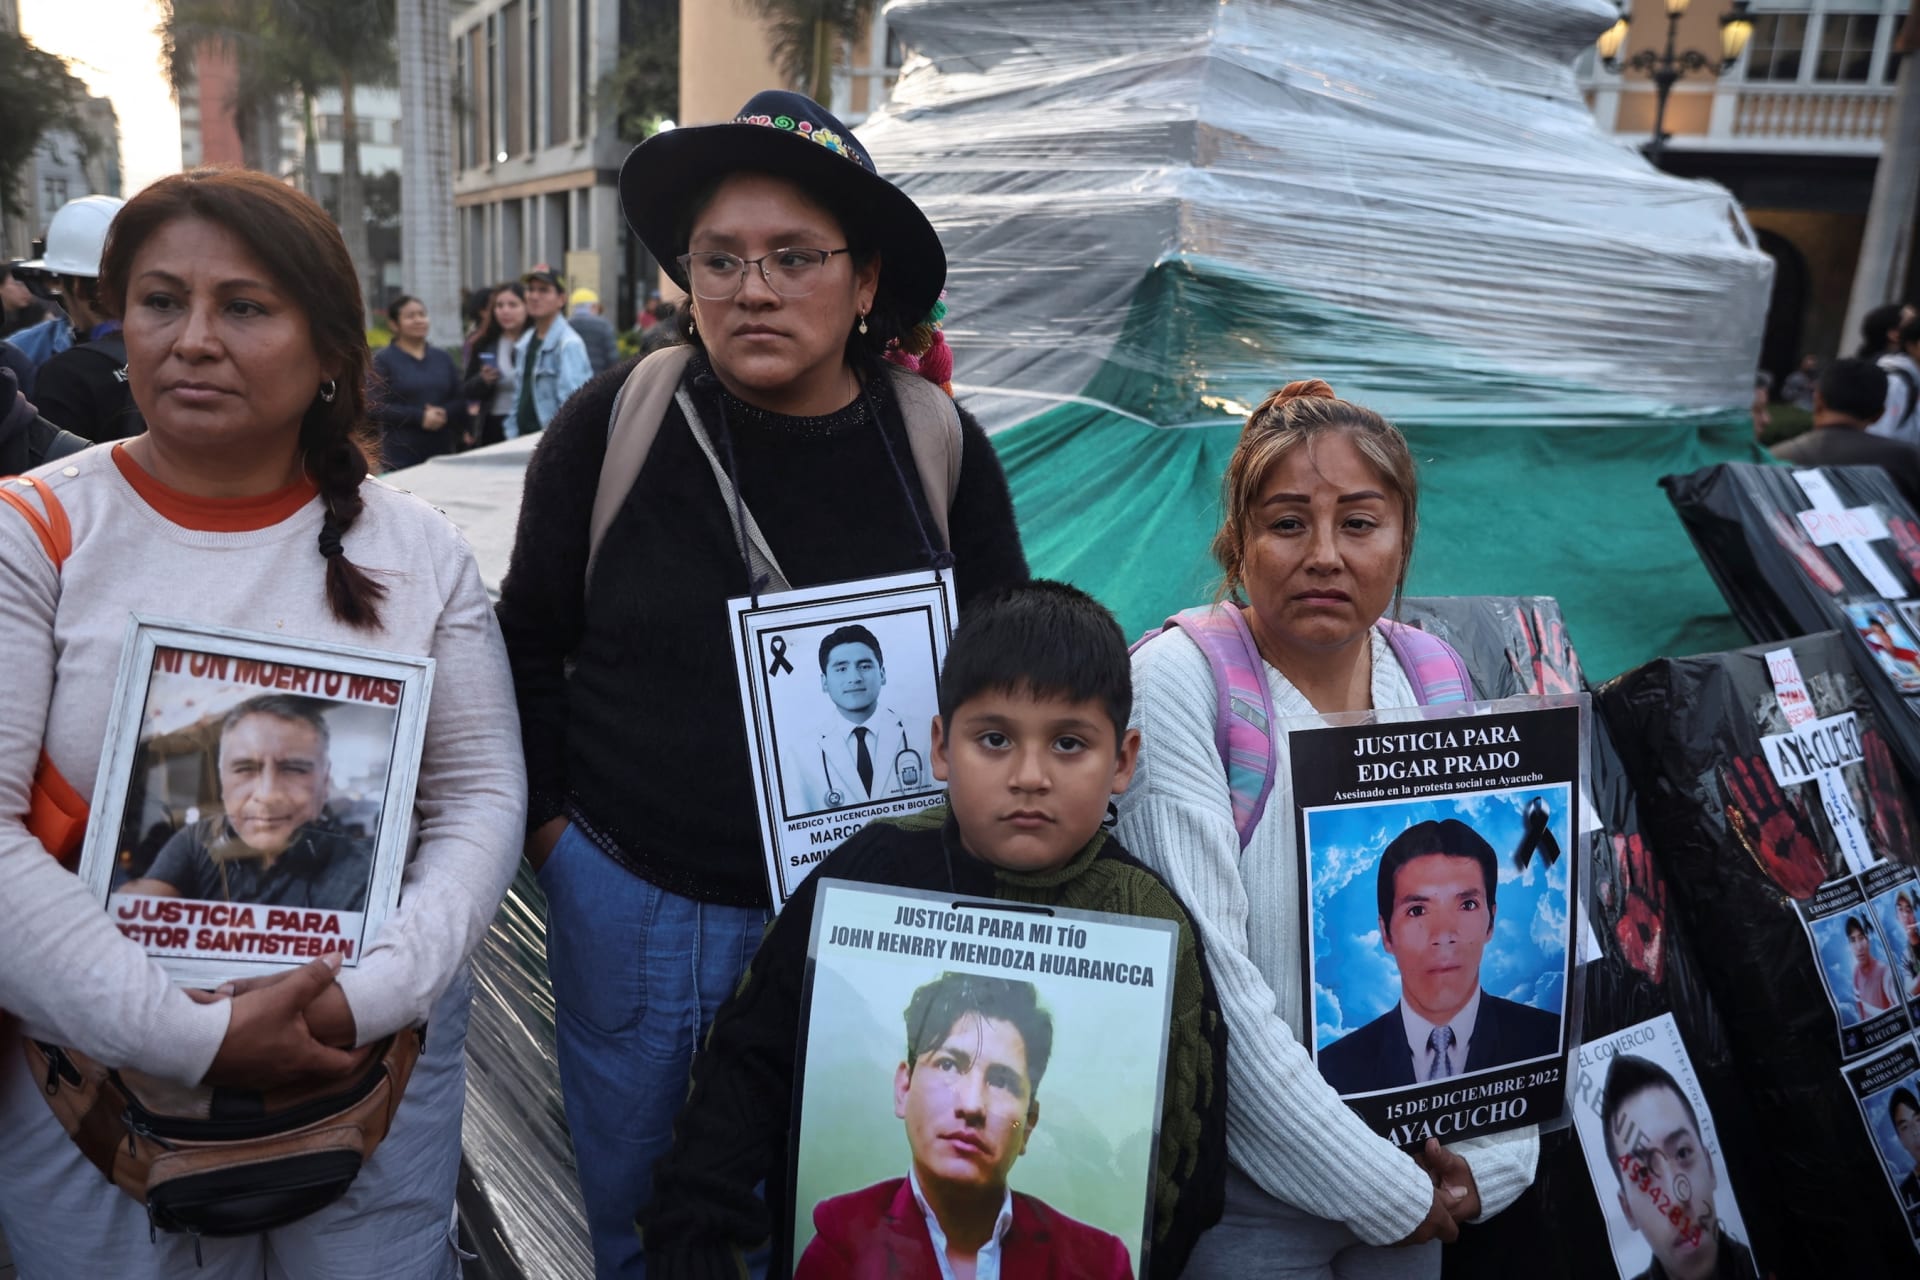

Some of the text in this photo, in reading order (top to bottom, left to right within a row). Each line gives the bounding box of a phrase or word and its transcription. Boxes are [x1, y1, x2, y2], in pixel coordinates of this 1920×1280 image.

[155, 650, 183, 674] NI
[234, 659, 342, 697] MUERTO
[1353, 725, 1521, 757] JUSTICIA PARA
[1775, 717, 1864, 777] AYACUCHO
[1334, 771, 1544, 801] Asesinado en la protesta social en Ayacucho
[1356, 750, 1520, 783] EDGAR PRADO
[788, 795, 945, 832] MEDICO Y LICENCIADO EN BIOLOGÍ
[790, 849, 833, 867] SAMI
[117, 900, 341, 935] JUSTICIA PARA
[894, 906, 1087, 949] JUSTICIA PARA MI TÍO
[195, 928, 354, 959] SANTISTEBAN
[829, 925, 1154, 987] JOHN HENRRY MENDOZA HUARANCCA
[1577, 1025, 1657, 1070] EL COMERCIO
[1386, 1068, 1560, 1120] 15 DE DICIEMBRE 2022
[1386, 1097, 1529, 1147] AYACUCHO
